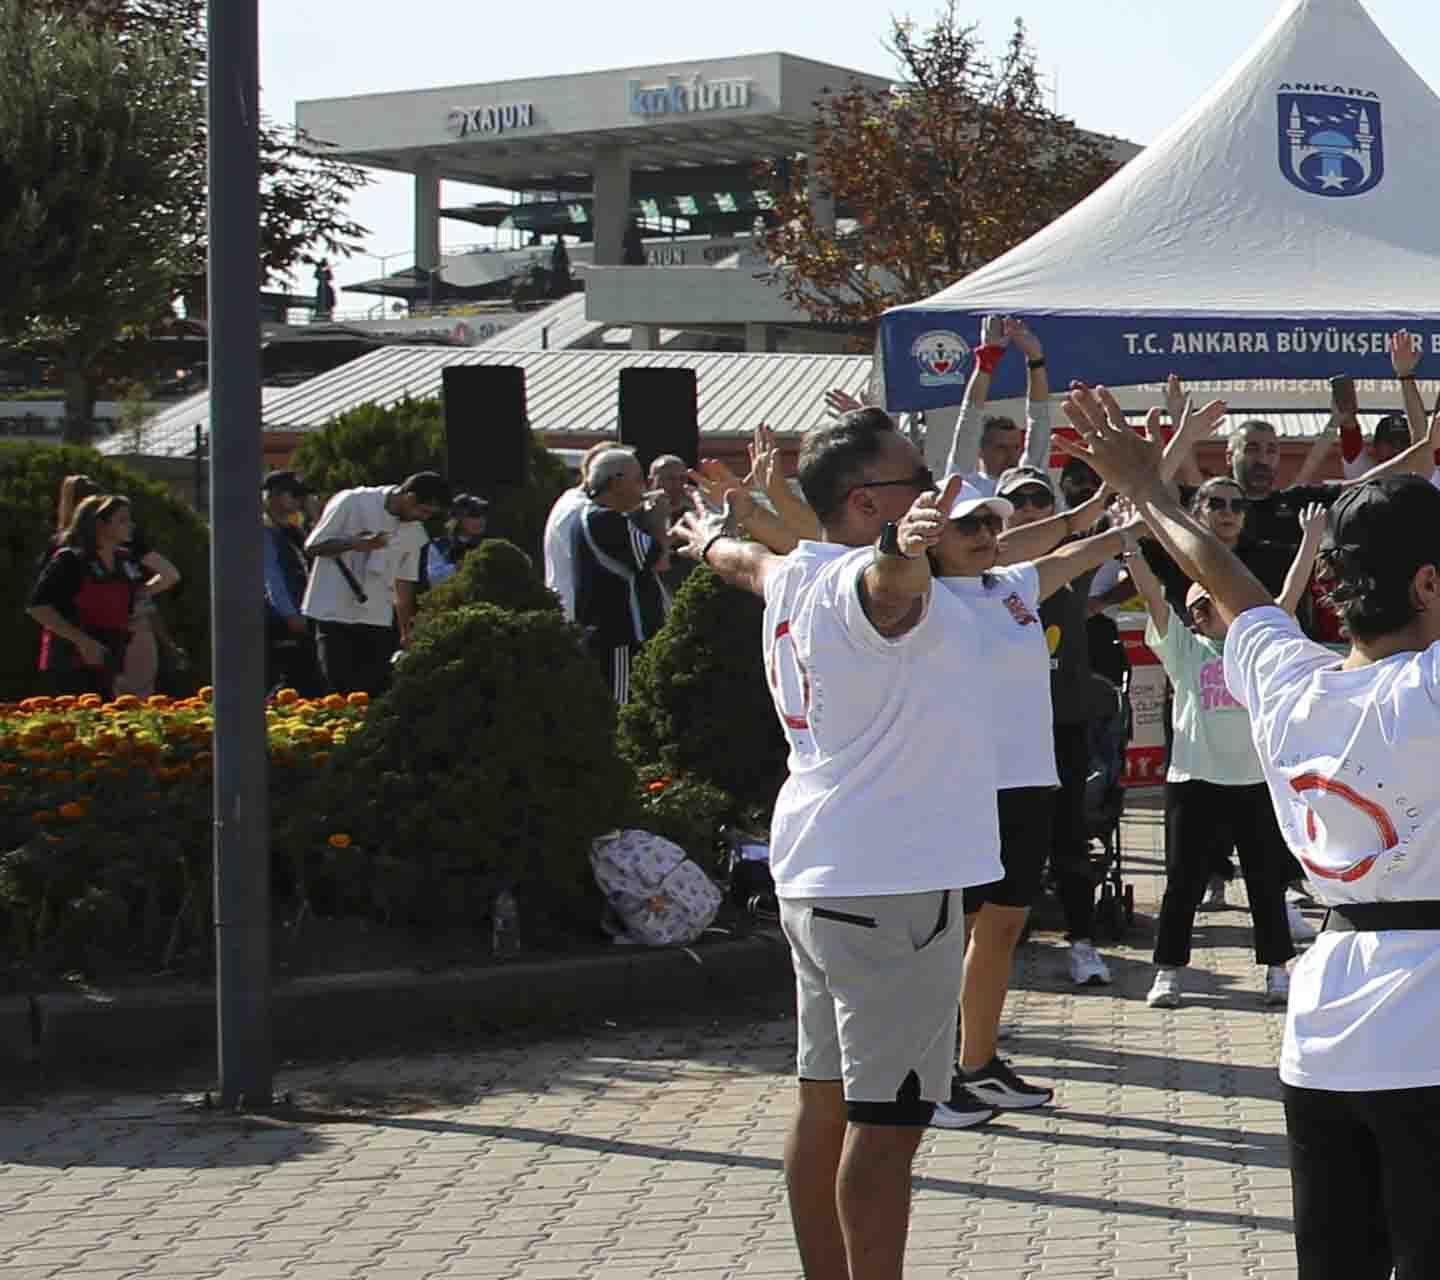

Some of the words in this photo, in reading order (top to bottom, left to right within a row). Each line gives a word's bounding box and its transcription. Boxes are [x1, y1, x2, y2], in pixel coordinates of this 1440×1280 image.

[1278, 81, 1380, 99] ANKARA
[1123, 332, 1164, 355] T.C.
[1171, 331, 1270, 354] ANKARA
[1276, 326, 1424, 359] BÜYÜKŞEHR
